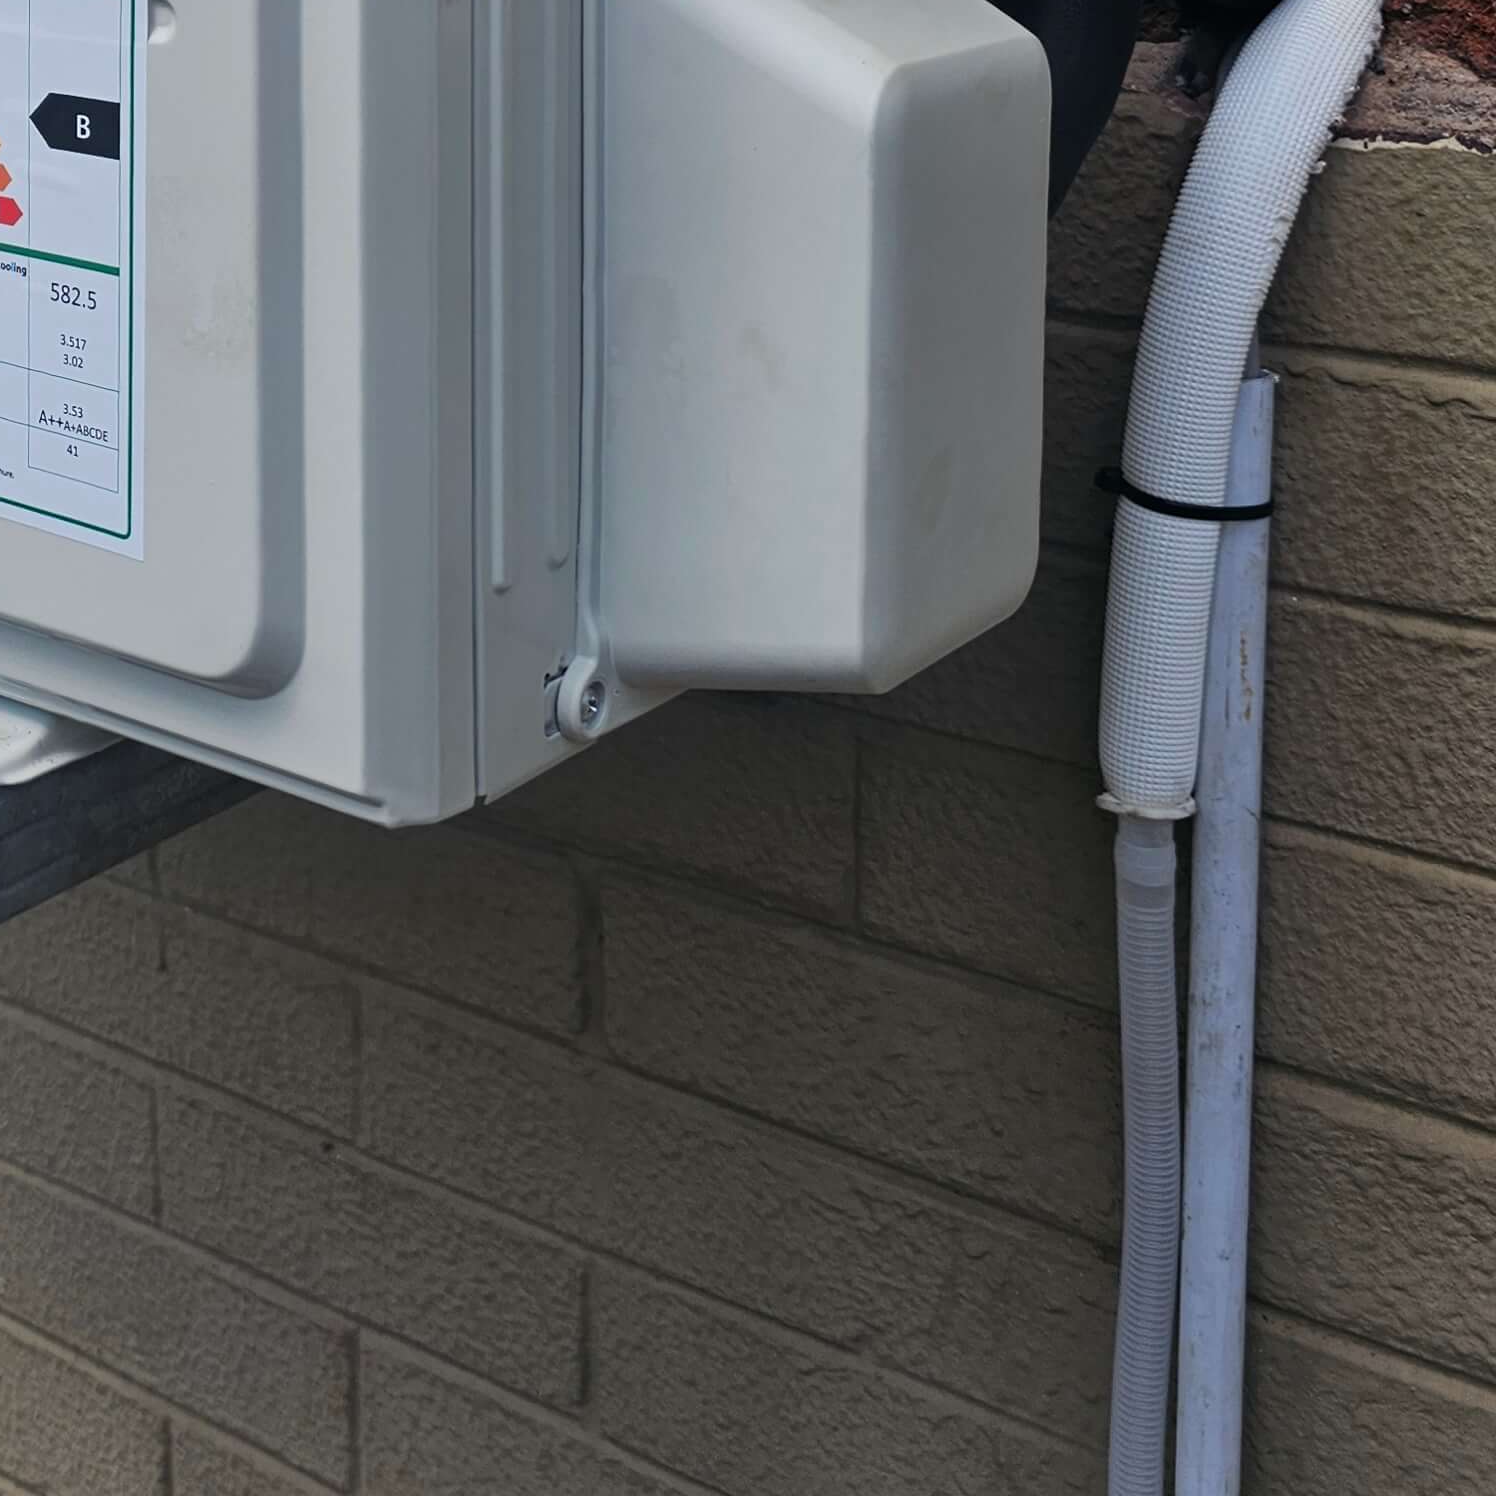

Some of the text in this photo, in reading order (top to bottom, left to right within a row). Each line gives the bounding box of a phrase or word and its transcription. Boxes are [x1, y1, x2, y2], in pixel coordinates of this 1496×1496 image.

[76, 115, 91, 139] B
[50, 282, 97, 310] 582.5
[59, 334, 87, 351] 3.517
[62, 353, 84, 369] 3.02
[62, 403, 84, 419] 3.53
[66, 444, 79, 457] 41
